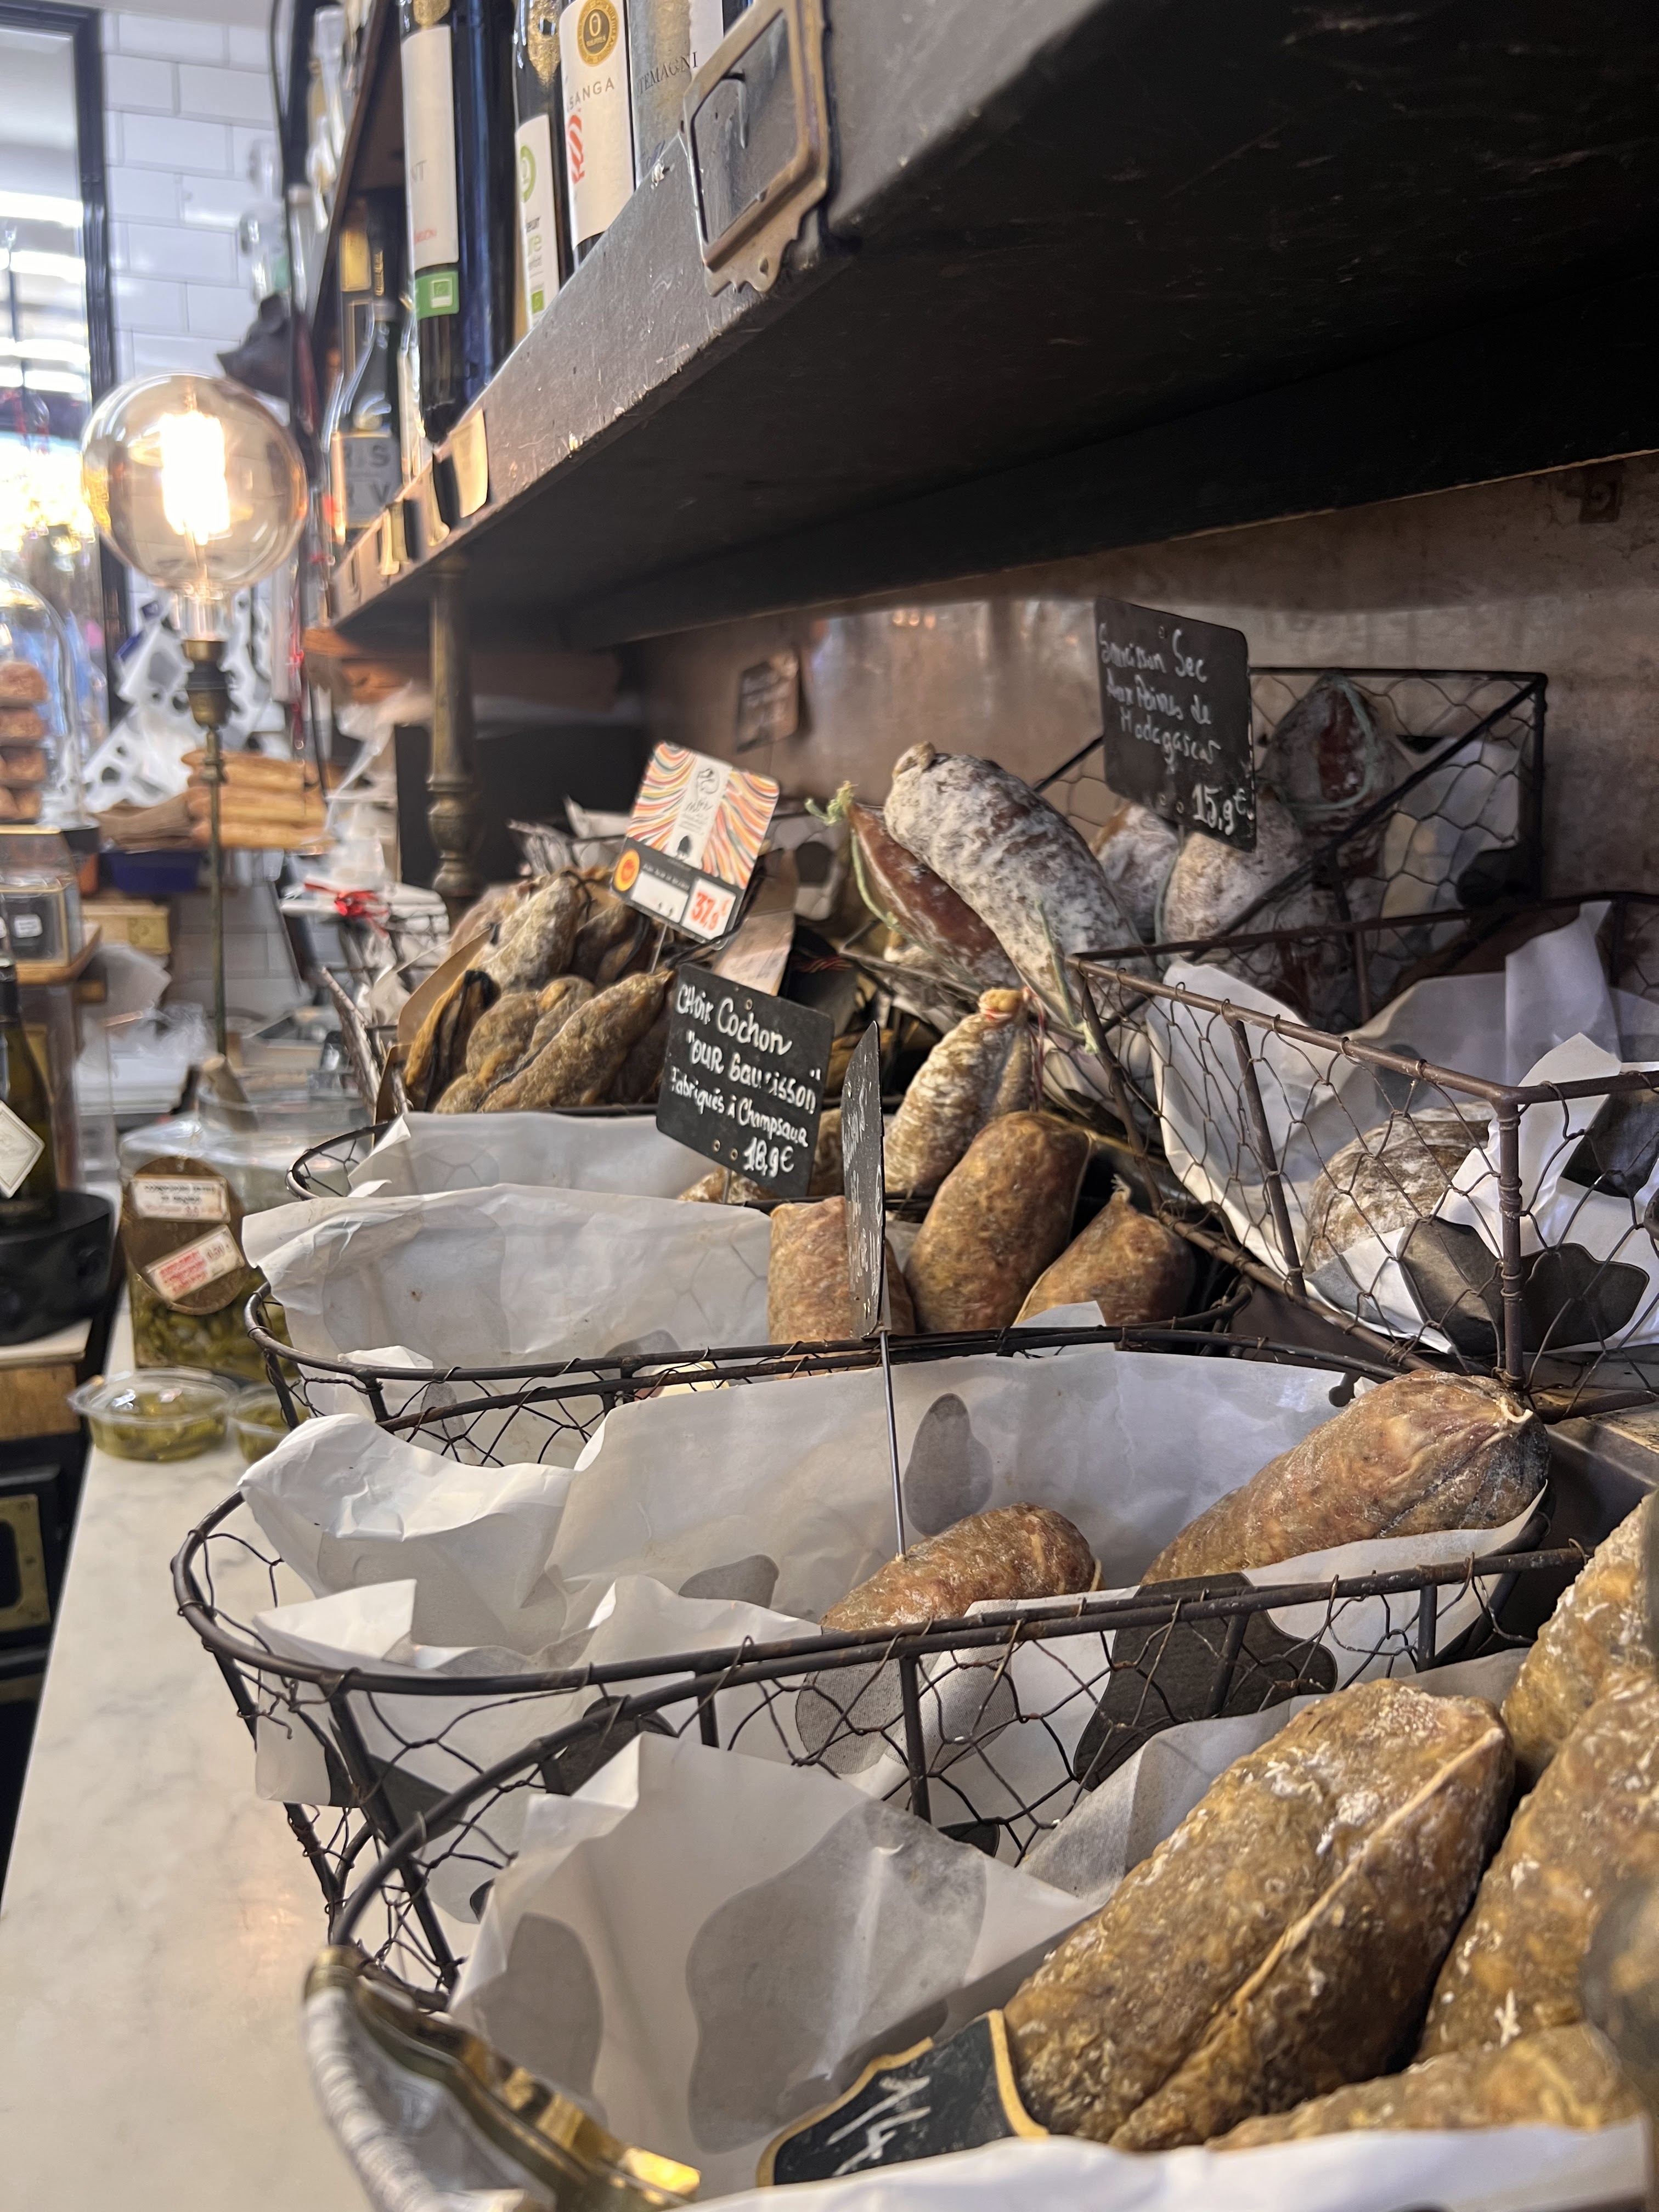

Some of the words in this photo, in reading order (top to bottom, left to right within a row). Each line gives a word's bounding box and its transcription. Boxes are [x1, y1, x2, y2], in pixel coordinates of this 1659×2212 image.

[568, 77, 614, 110] SANGA
[1172, 629, 1207, 682] Sec
[716, 996, 793, 1055] Cochon
[743, 1137, 794, 1178] 18,9€
